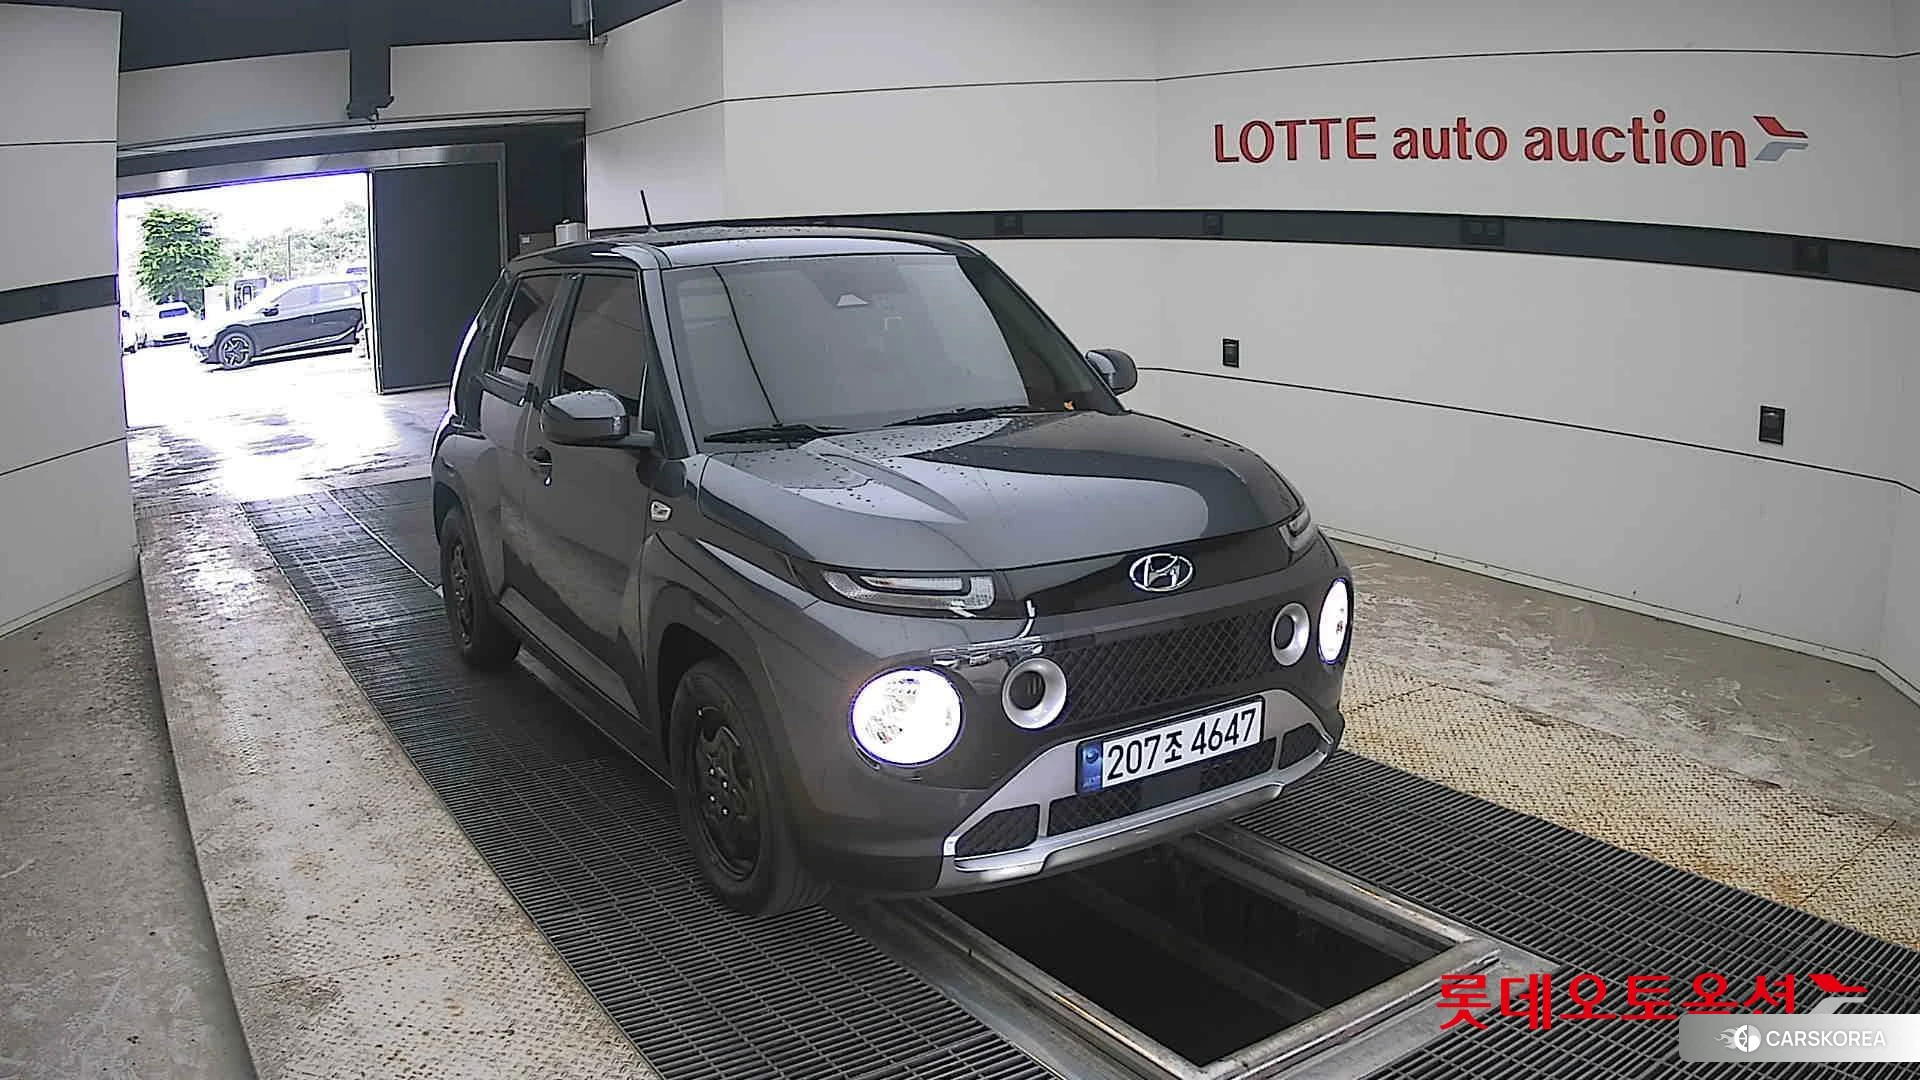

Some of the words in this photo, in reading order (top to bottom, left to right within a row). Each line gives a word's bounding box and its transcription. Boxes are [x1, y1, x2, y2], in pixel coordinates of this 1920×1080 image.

[1214, 116, 1376, 162] LOTTE
[1392, 117, 1508, 160] auto
[1523, 109, 1747, 168] auction
[1107, 730, 1184, 781] 207조
[1190, 707, 1257, 755] 4647
